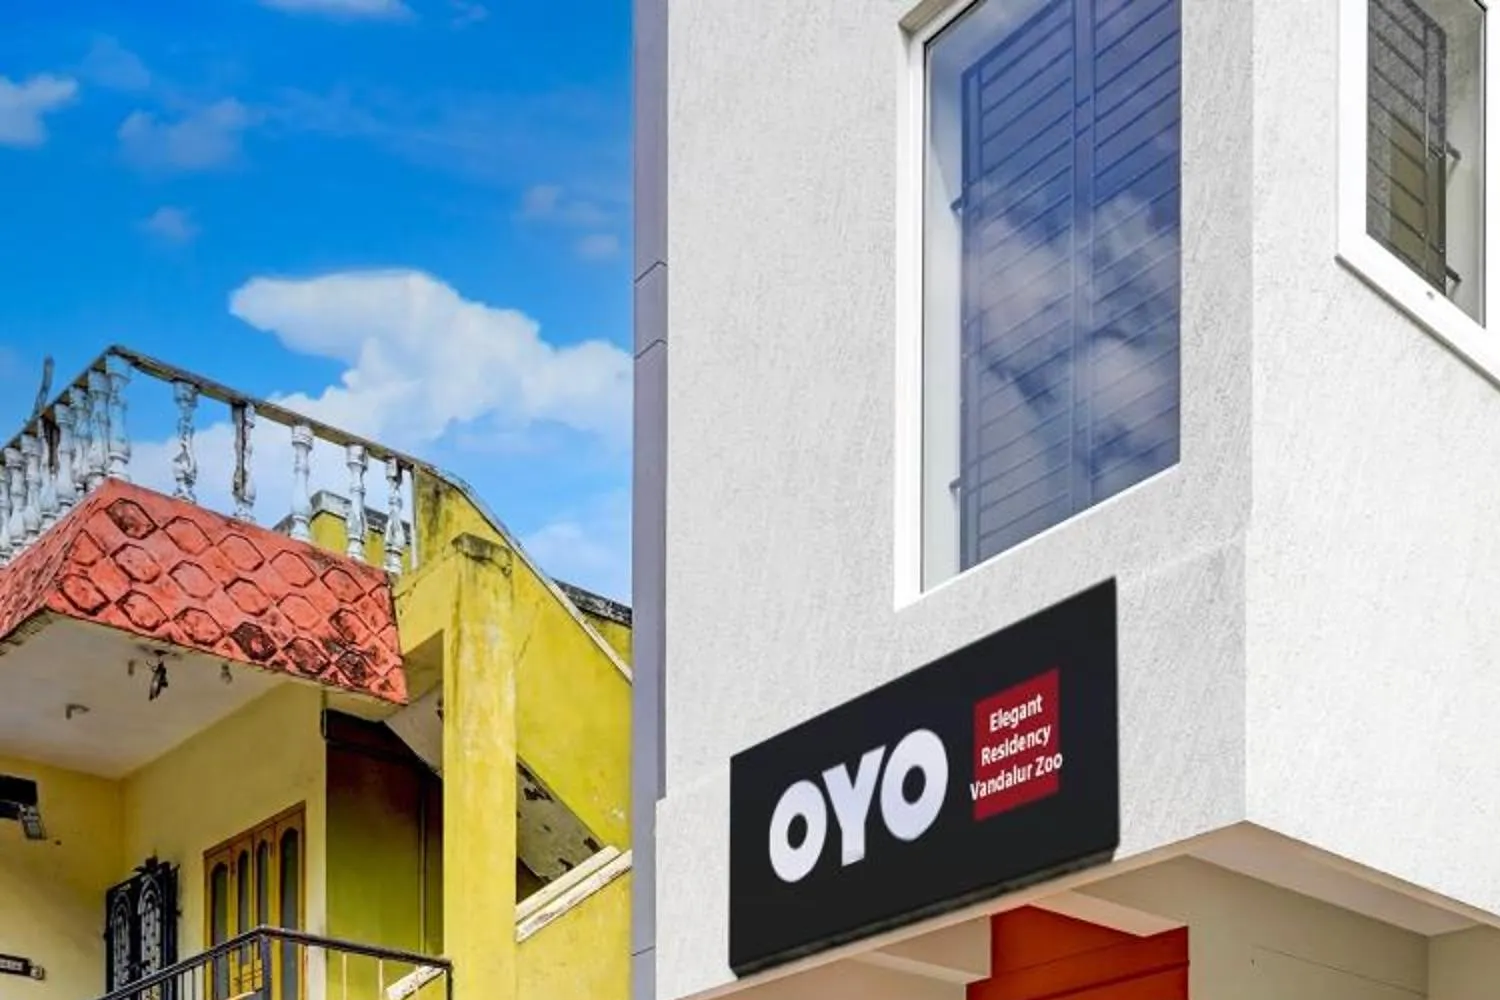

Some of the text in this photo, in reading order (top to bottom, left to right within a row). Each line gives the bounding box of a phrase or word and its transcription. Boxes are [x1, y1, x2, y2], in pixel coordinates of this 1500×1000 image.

[989, 694, 1043, 733] Elegant
[981, 724, 1051, 767] Residency
[969, 752, 1063, 801] Vandalur Zoo
[769, 728, 949, 883] OYO
